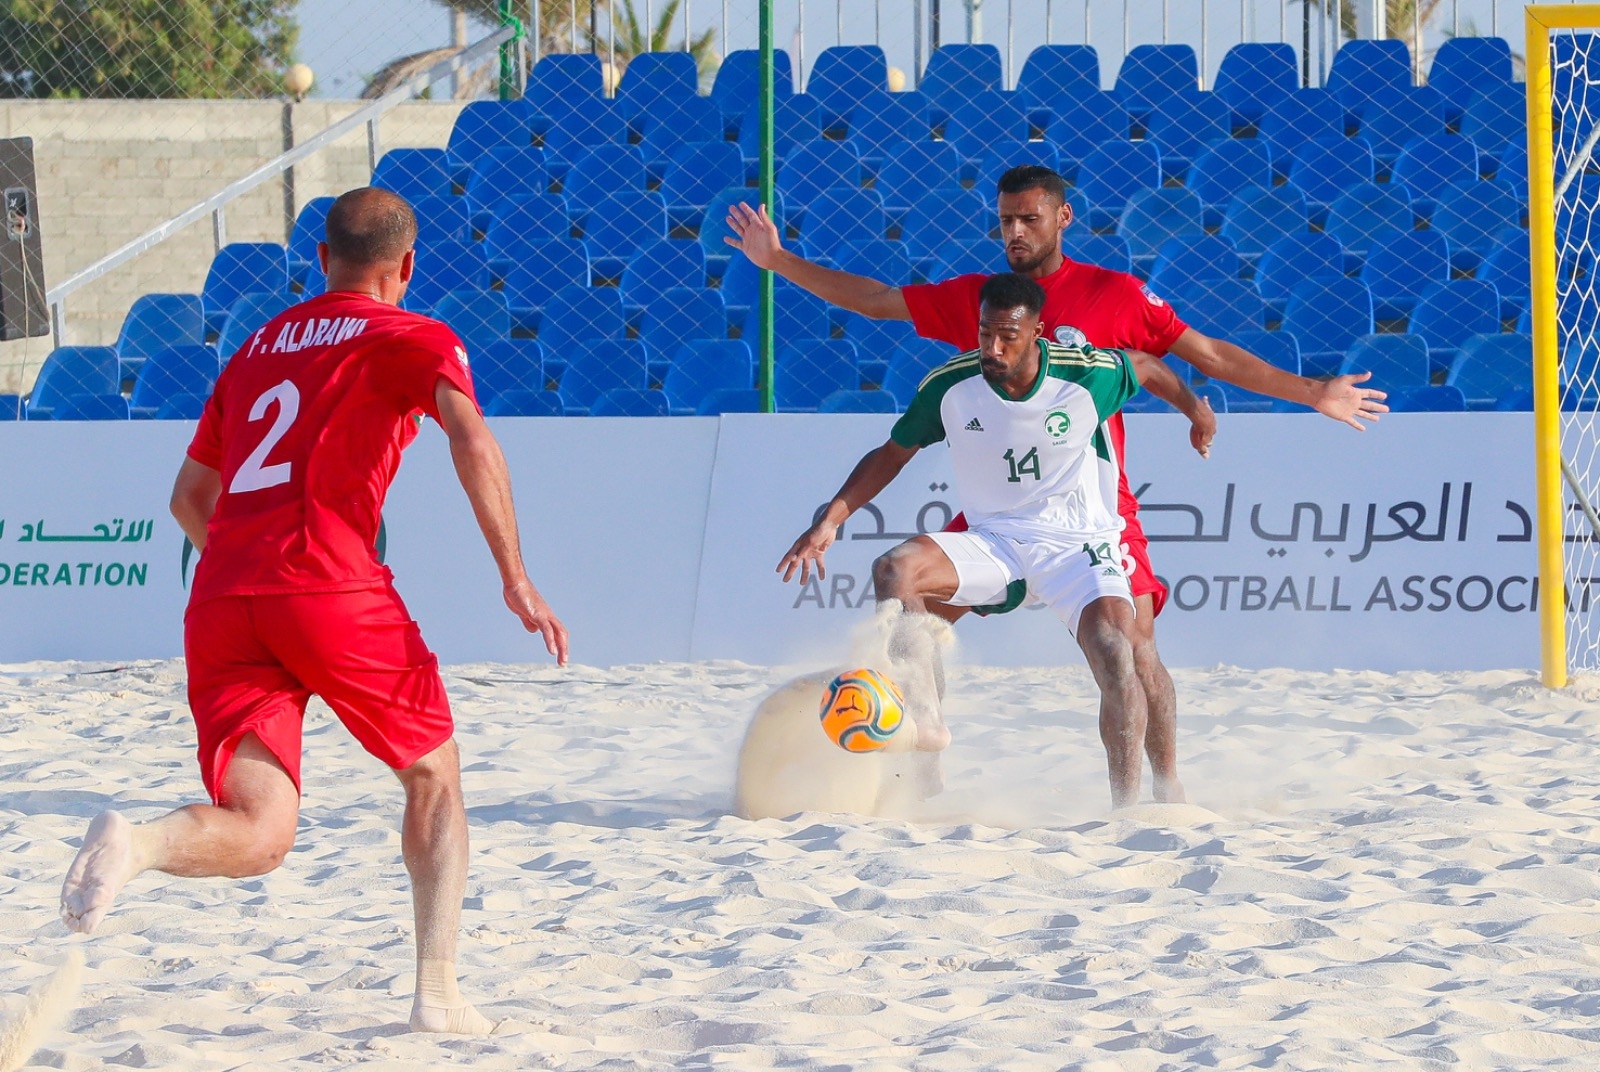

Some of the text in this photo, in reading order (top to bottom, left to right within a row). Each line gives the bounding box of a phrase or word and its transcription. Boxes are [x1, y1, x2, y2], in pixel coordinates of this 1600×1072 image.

[247, 316, 370, 359] F. ALARAWI
[228, 378, 301, 494] 2
[1002, 446, 1042, 483] 14
[18, 518, 154, 542] الاتحاد
[1249, 482, 1473, 563] العربي
[1153, 575, 1352, 612] OTBALL
[1363, 575, 1600, 613] ASSOCIT
